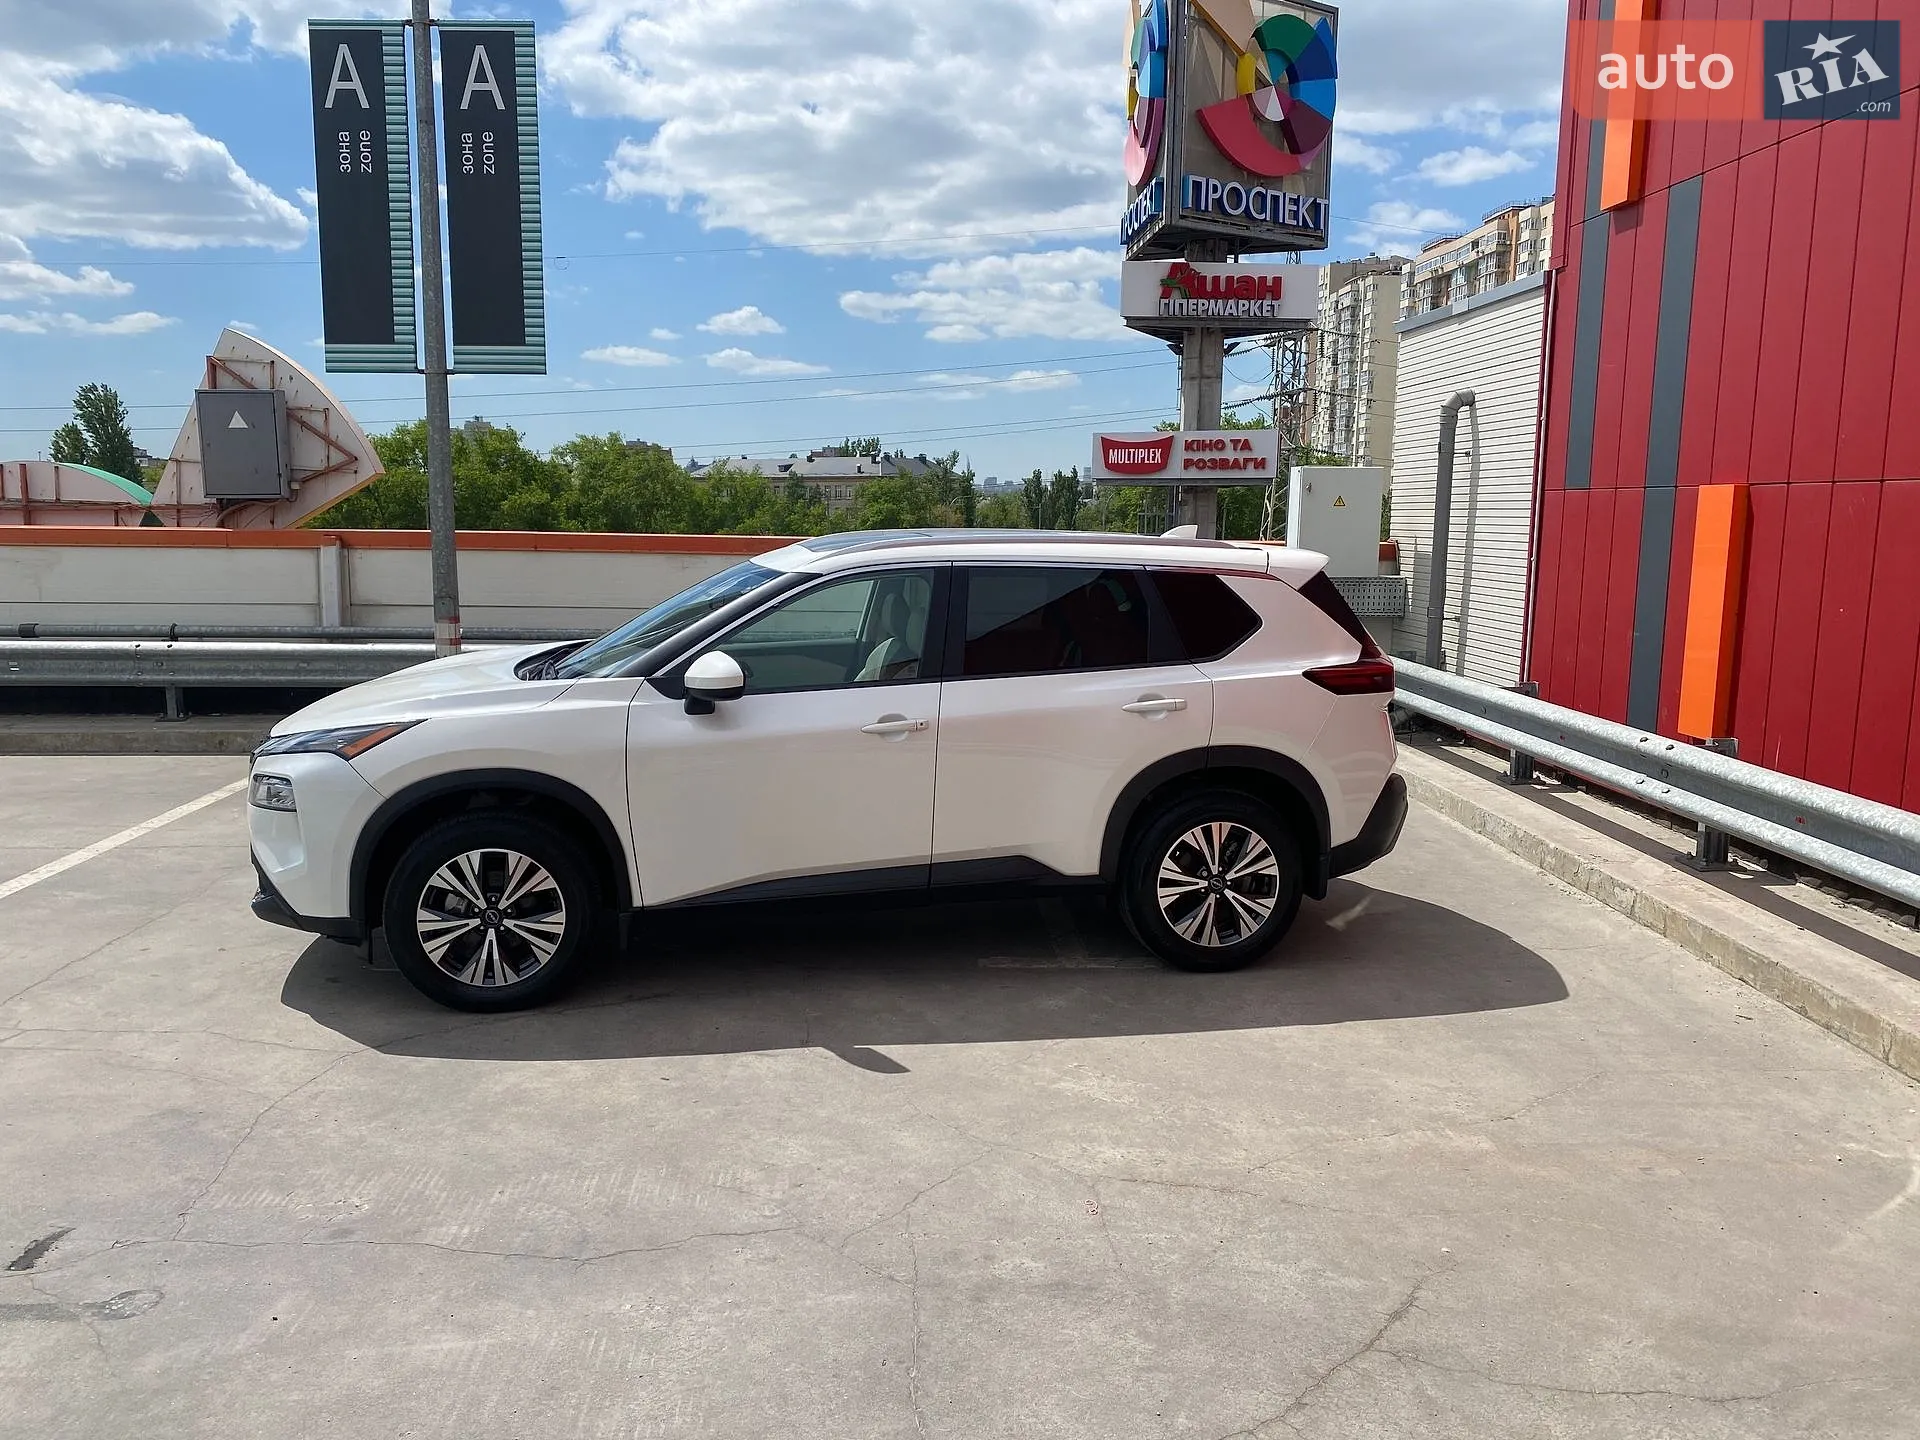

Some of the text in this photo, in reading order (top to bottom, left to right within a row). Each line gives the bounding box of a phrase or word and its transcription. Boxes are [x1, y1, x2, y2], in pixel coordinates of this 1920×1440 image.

[338, 130, 351, 173] зона
[360, 129, 372, 173] zone
[462, 132, 474, 174] зона
[482, 131, 496, 175] zone
[1187, 175, 1329, 237] ПРОСПЕКТ
[1160, 262, 1282, 300] Ашан
[1159, 299, 1281, 317] ГІПЕРМАРКЕТ
[1108, 448, 1162, 464] MULTIPLEX
[1183, 438, 1253, 452] КІНО ТА
[1183, 457, 1266, 471] РОЗВАГИ
